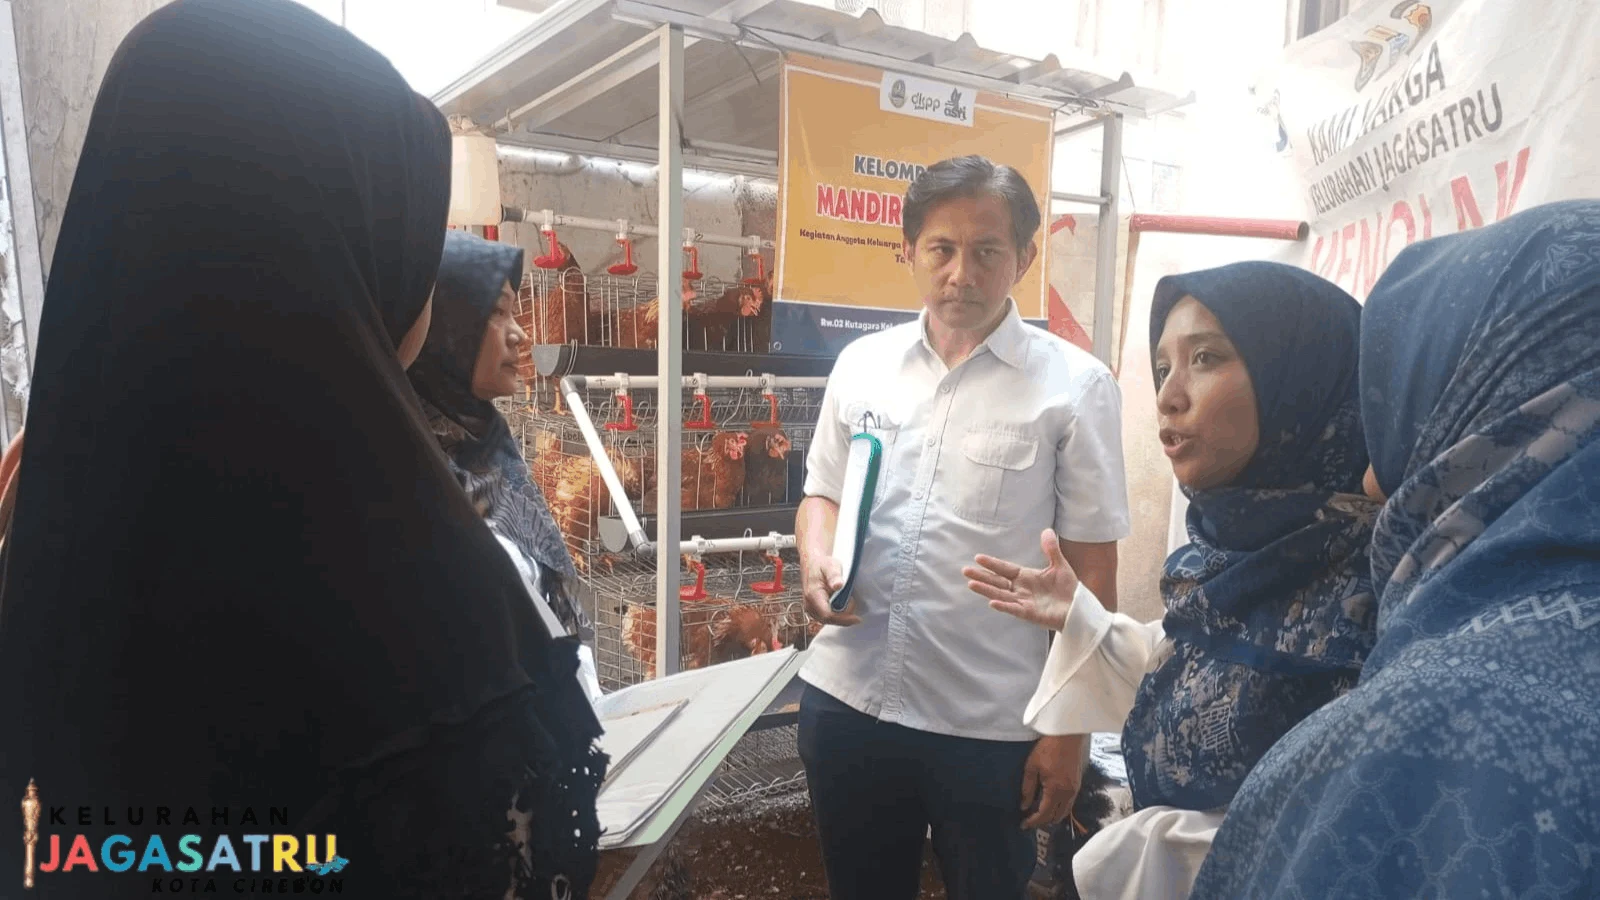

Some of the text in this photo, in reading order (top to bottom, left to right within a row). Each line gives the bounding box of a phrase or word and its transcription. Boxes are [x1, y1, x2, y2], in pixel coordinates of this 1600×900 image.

[1311, 83, 1502, 215] KELURAHAN JAGASATRU
[854, 155, 927, 181] KELOMP
[817, 184, 904, 226] MANDIR
[800, 228, 902, 250] Kegiatan Anggota Keluarga
[820, 317, 844, 328] Rw.02
[845, 320, 880, 331] Kutagara
